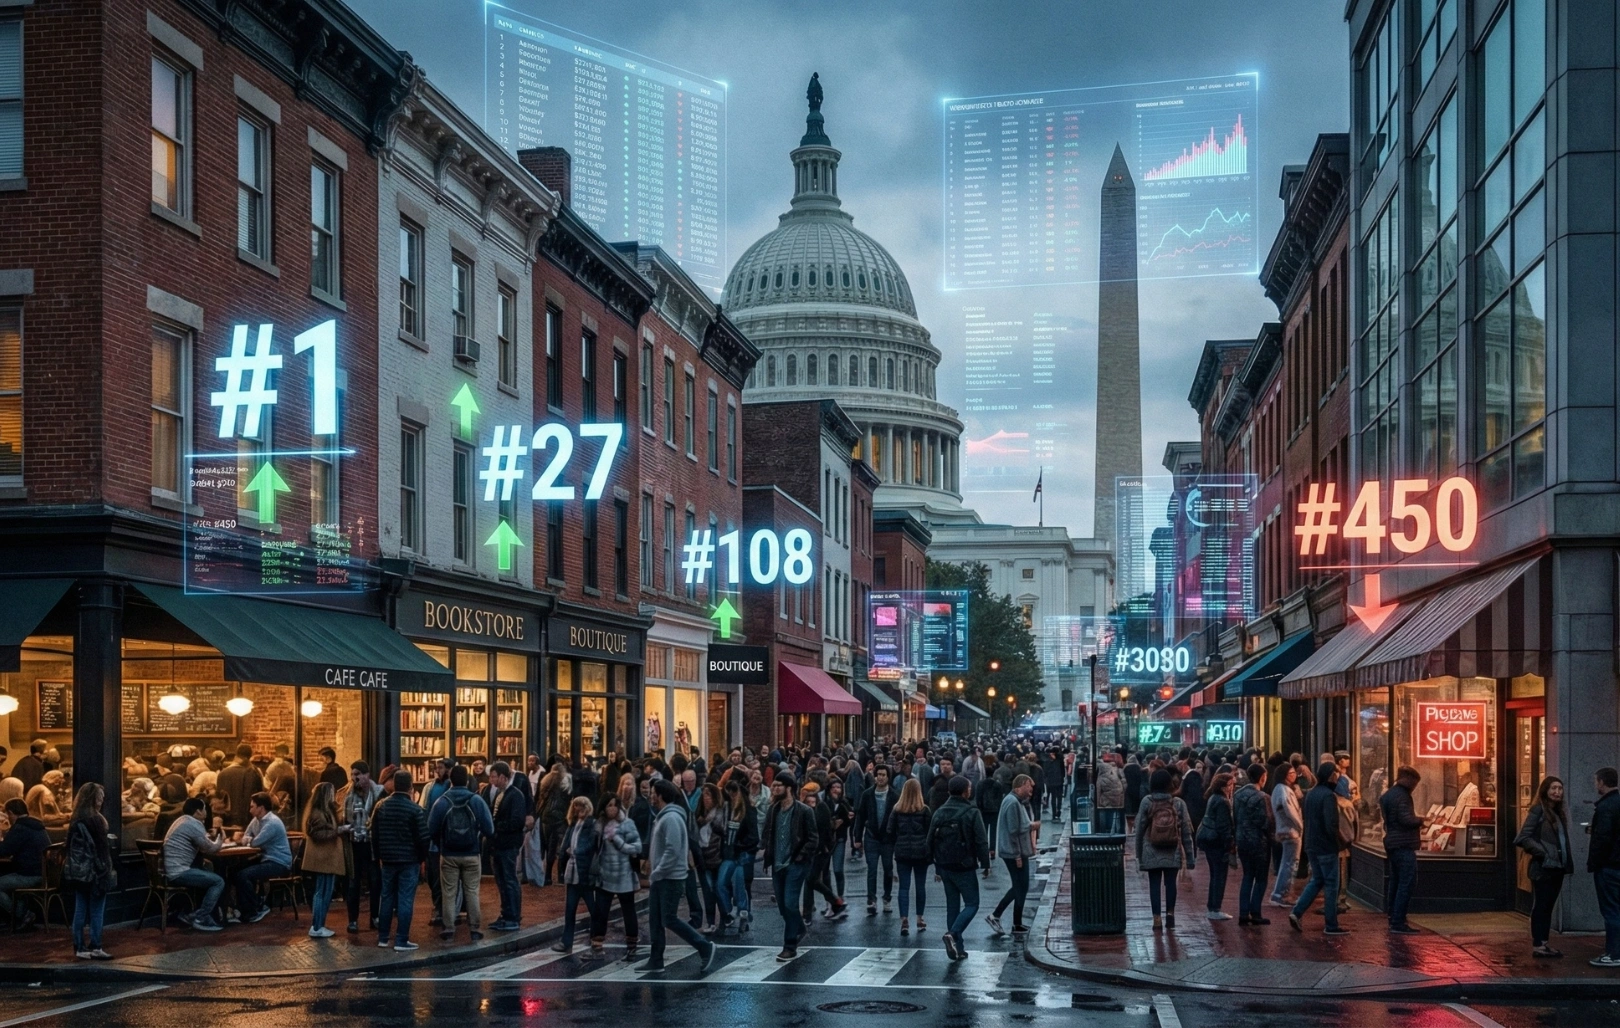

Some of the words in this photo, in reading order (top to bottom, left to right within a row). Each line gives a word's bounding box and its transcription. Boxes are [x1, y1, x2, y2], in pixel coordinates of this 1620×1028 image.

[210, 319, 336, 438] #1
[479, 423, 623, 501] #27
[1295, 477, 1478, 555] #450
[682, 528, 813, 584] #108
[425, 600, 524, 640] BOOKSTORE
[570, 626, 627, 654] BOUTIQUE
[709, 660, 763, 673] BOUTIQUE
[1115, 647, 1189, 672] #3080
[325, 668, 356, 686] CAFE
[360, 671, 388, 688] CAFE
[1426, 730, 1479, 752] SHOP
